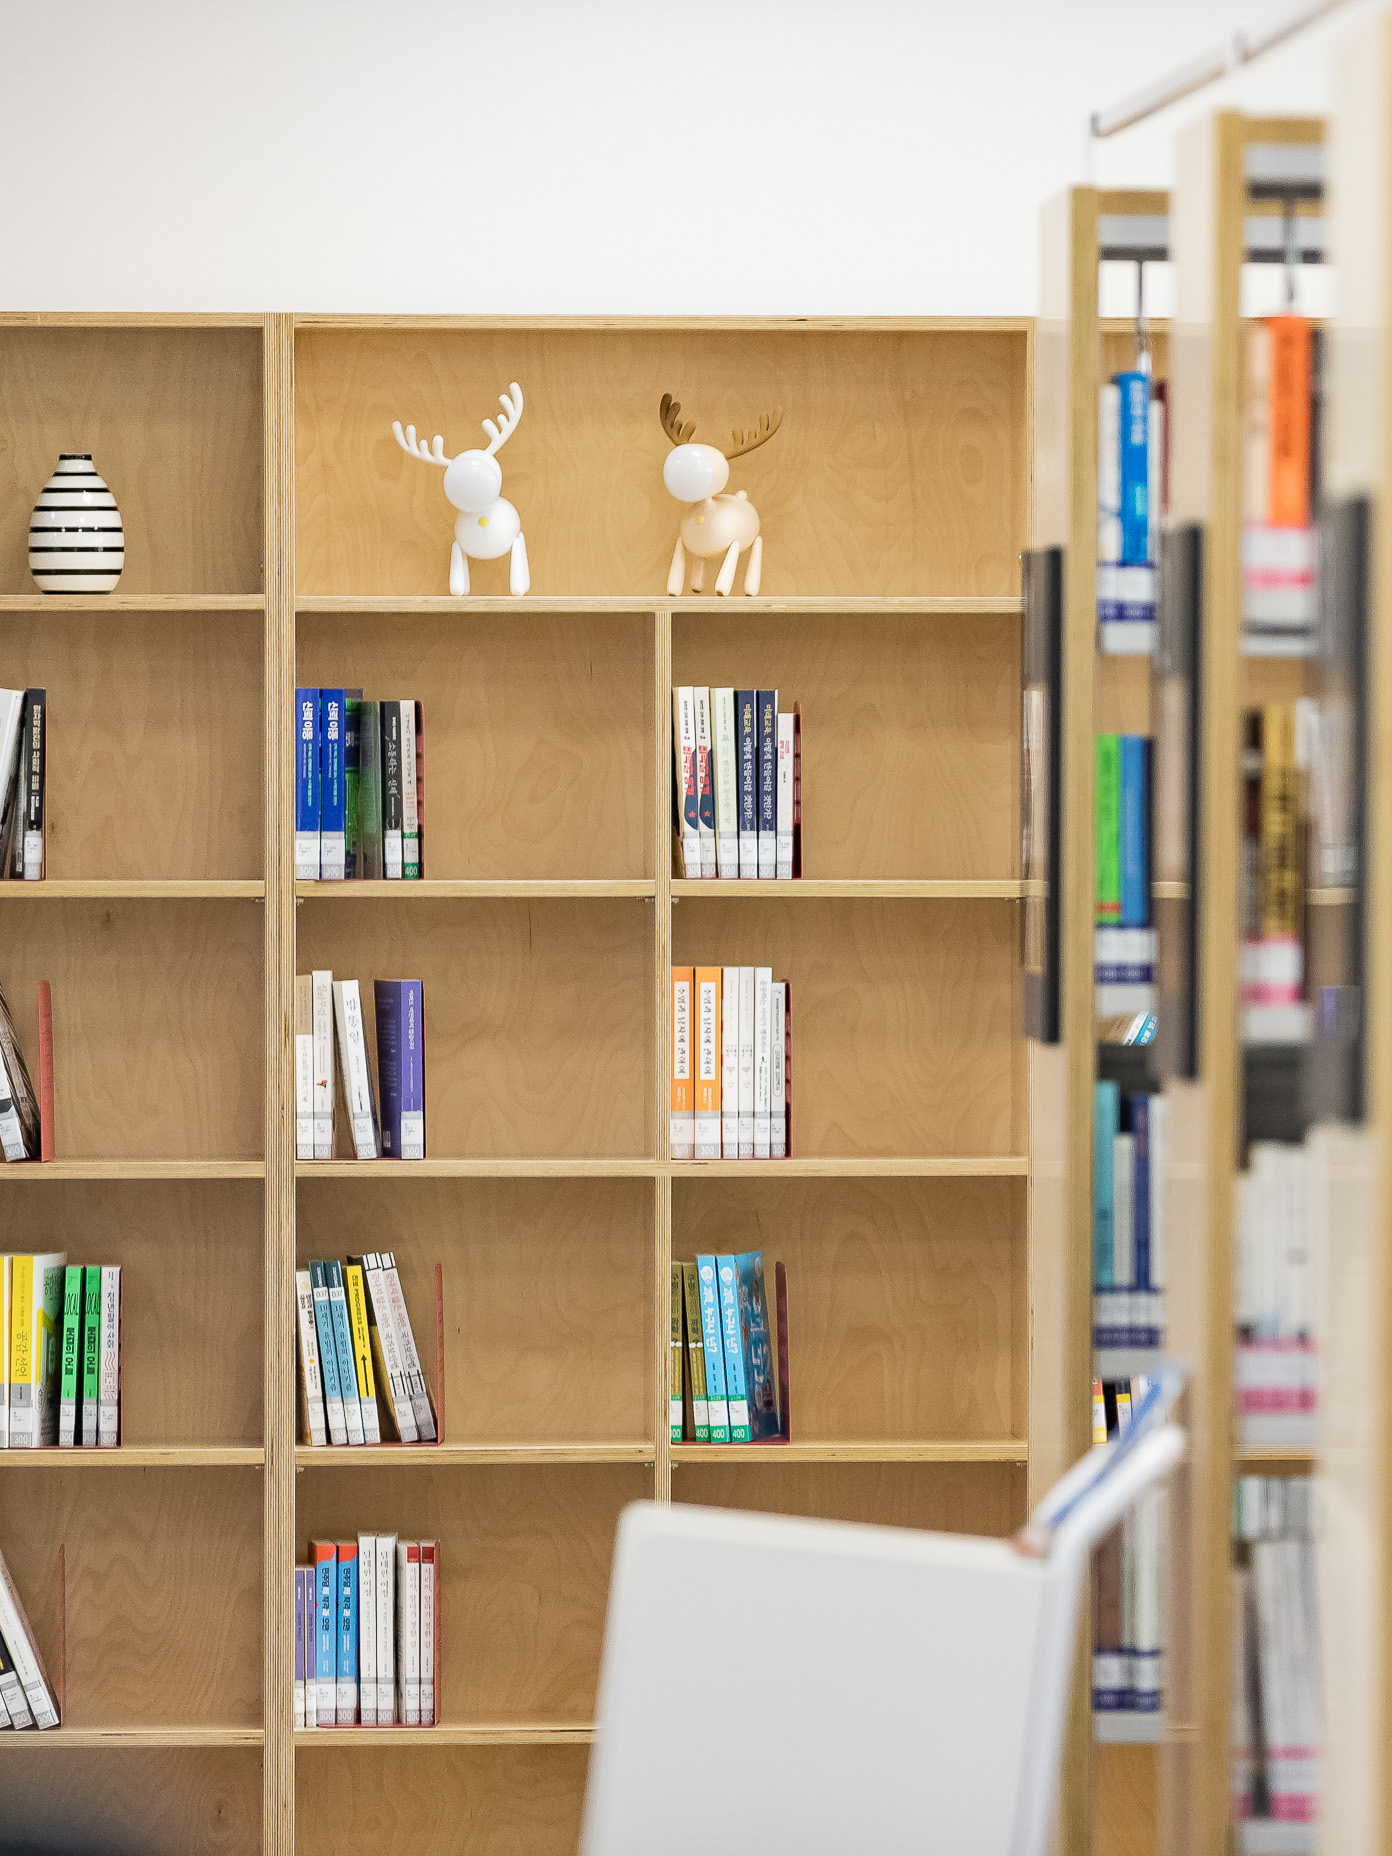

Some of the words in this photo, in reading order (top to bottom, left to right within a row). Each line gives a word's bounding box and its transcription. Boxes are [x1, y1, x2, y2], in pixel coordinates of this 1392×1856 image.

[302, 701, 314, 720] 신뢰
[327, 701, 339, 720] 신뢰
[743, 704, 752, 734] 미래교육
[764, 704, 772, 734] 미래교육
[302, 721, 314, 741] 이동
[327, 721, 339, 741] 이동
[743, 737, 752, 759] 어떻게
[764, 737, 772, 759] 어떻게
[388, 742, 398, 775] 소통하는
[388, 777, 398, 795] 신뢰
[743, 762, 752, 791] 만들어갈
[764, 762, 772, 791] 만들어갈
[743, 794, 753, 819] 것인가?
[764, 794, 772, 819] 것인가?
[299, 866, 314, 876] 300
[325, 866, 340, 876] 300
[405, 866, 418, 876] 400
[722, 866, 735, 875] 300
[741, 866, 755, 875] 300
[759, 866, 773, 875] 300
[677, 987, 686, 1012] 수염과
[703, 988, 712, 1013] 수염과
[677, 1017, 686, 1043] 남자에
[703, 1018, 712, 1044] 남자에
[677, 1048, 686, 1074] 관하여
[703, 1048, 712, 1074] 관하여
[6, 1146, 20, 1156] 300
[405, 1147, 419, 1156] 300
[701, 1146, 714, 1155] 300
[353, 1288, 363, 1325] PROGRESS
[15, 1331, 28, 1354] 공감
[385, 1332, 400, 1370] 국가보안법
[401, 1331, 417, 1369] 국가보안법
[15, 1356, 28, 1377] 선언
[14, 1434, 28, 1444] 300
[671, 1429, 680, 1438] 00
[696, 1428, 709, 1438] 400
[712, 1429, 725, 1438] 400
[732, 1429, 745, 1438] 400
[322, 1617, 330, 1631] 오만
[343, 1618, 351, 1631] 오만
[361, 1710, 375, 1720] 300
